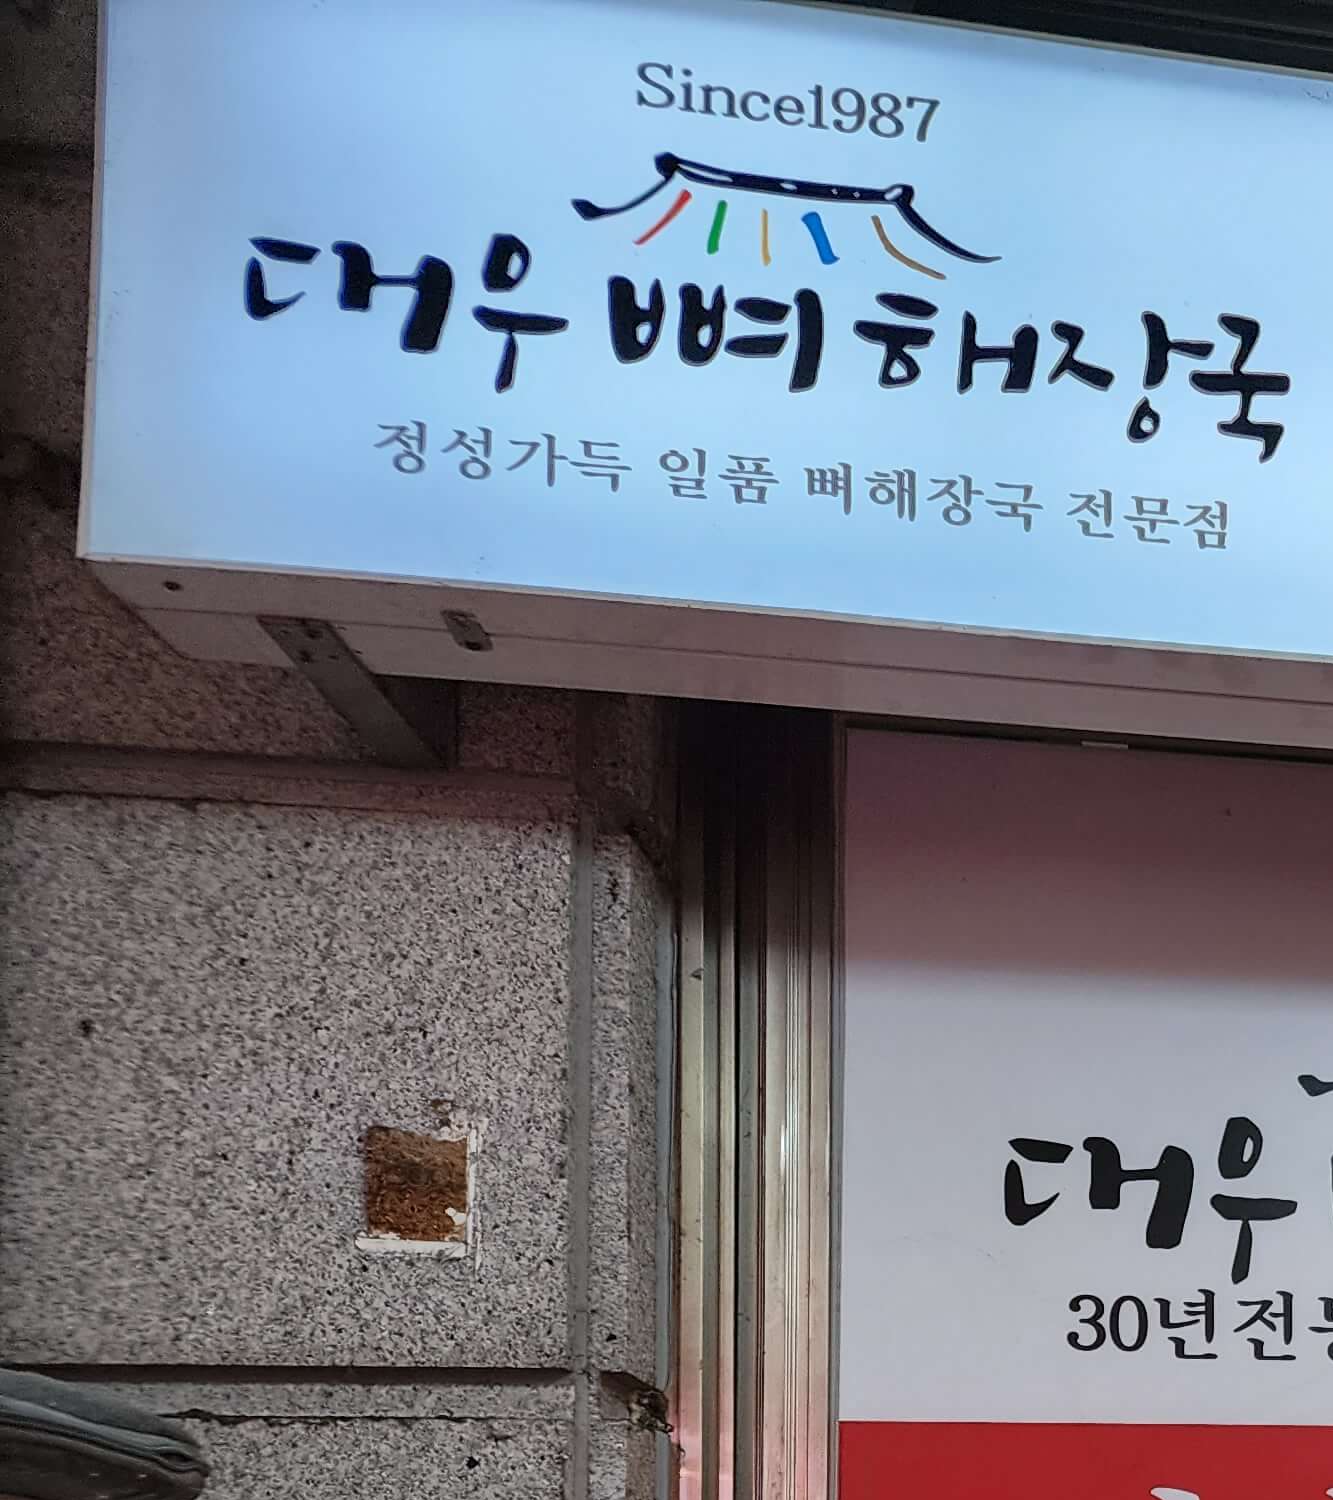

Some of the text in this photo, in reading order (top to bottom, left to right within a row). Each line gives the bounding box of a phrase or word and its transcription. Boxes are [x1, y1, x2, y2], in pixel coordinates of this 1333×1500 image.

[635, 60, 941, 144] Since1987
[245, 232, 568, 392] 대우
[854, 290, 1291, 463] 해장국
[375, 419, 1231, 550] 정성가득 일품 뼈해장국 전문점
[1004, 1116, 1297, 1283] 대우
